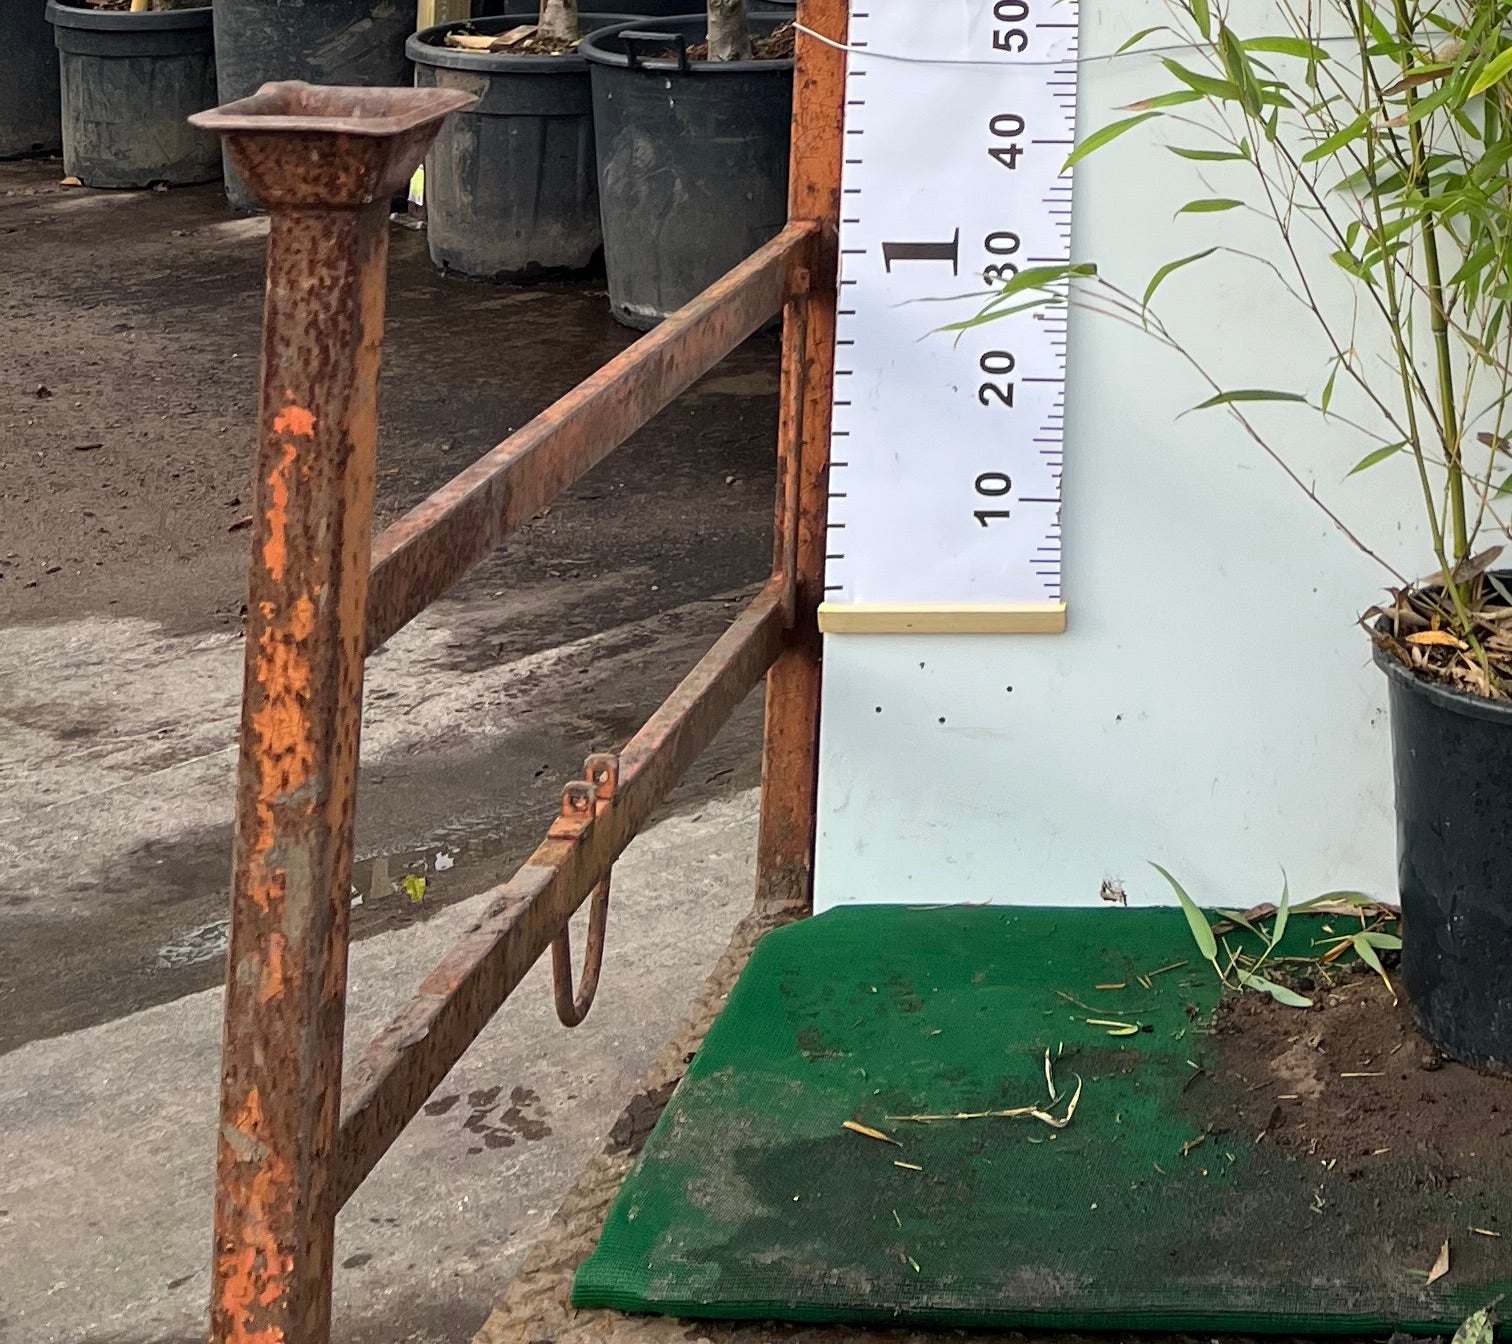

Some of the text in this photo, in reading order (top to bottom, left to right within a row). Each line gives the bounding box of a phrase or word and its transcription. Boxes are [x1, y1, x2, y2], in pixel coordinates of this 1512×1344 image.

[987, 113, 1026, 170] 40
[881, 227, 960, 276] 1
[983, 231, 1021, 287] 30
[978, 350, 1016, 408] 20
[972, 472, 1013, 527] 10
